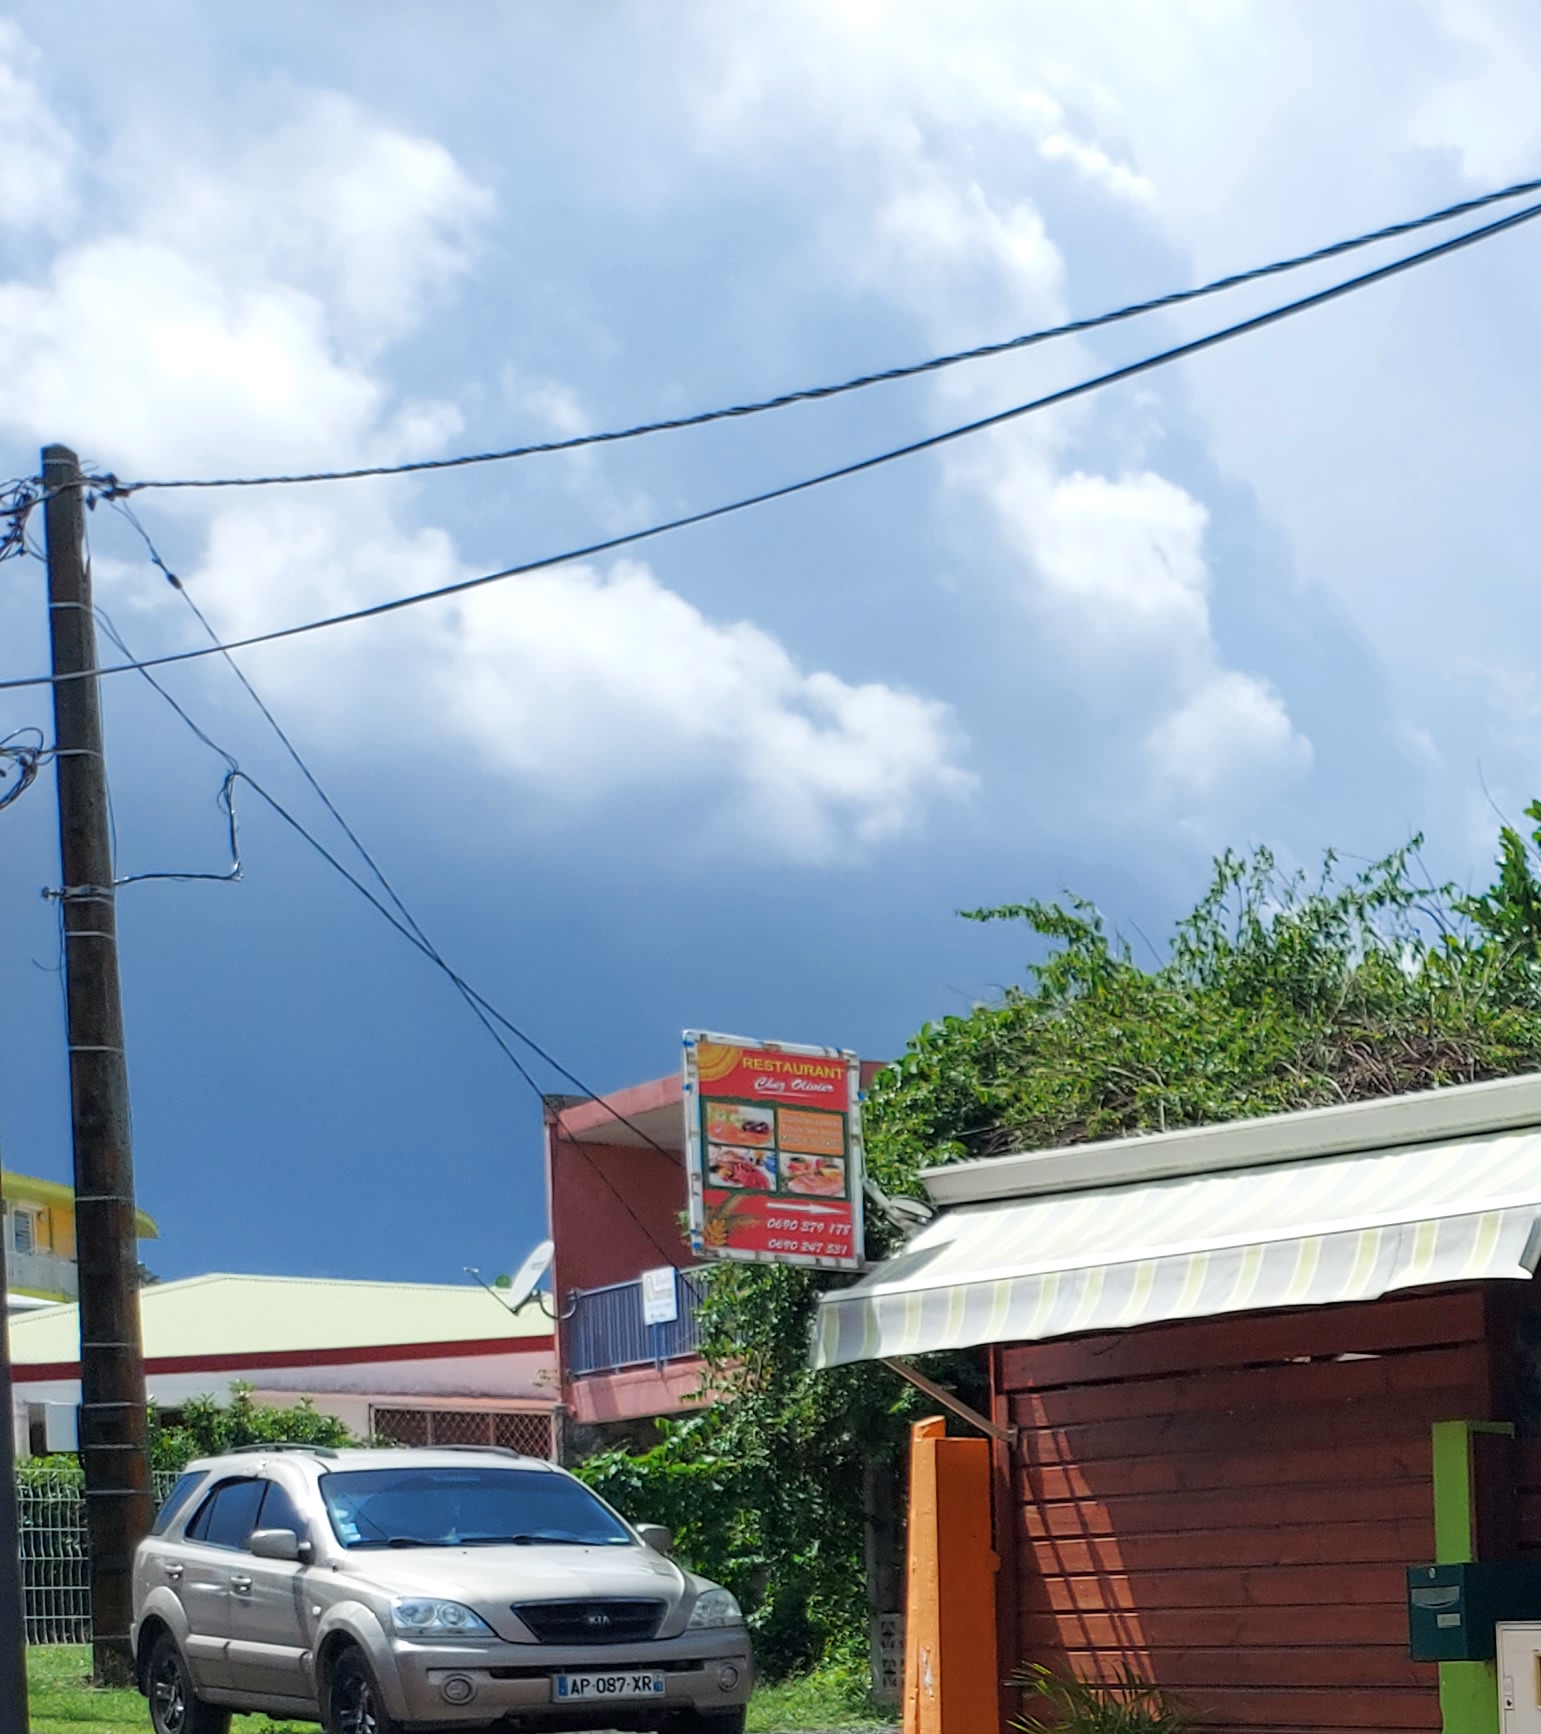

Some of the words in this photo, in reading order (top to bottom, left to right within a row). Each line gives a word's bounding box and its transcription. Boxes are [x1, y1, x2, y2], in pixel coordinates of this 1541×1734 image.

[742, 1057, 844, 1080] RESTAURANT
[754, 1077, 785, 1092] Chez
[792, 1079, 834, 1093] Olivier
[767, 1218, 796, 1230] 0690
[830, 1224, 851, 1236] 178
[768, 1238, 797, 1250] 0690
